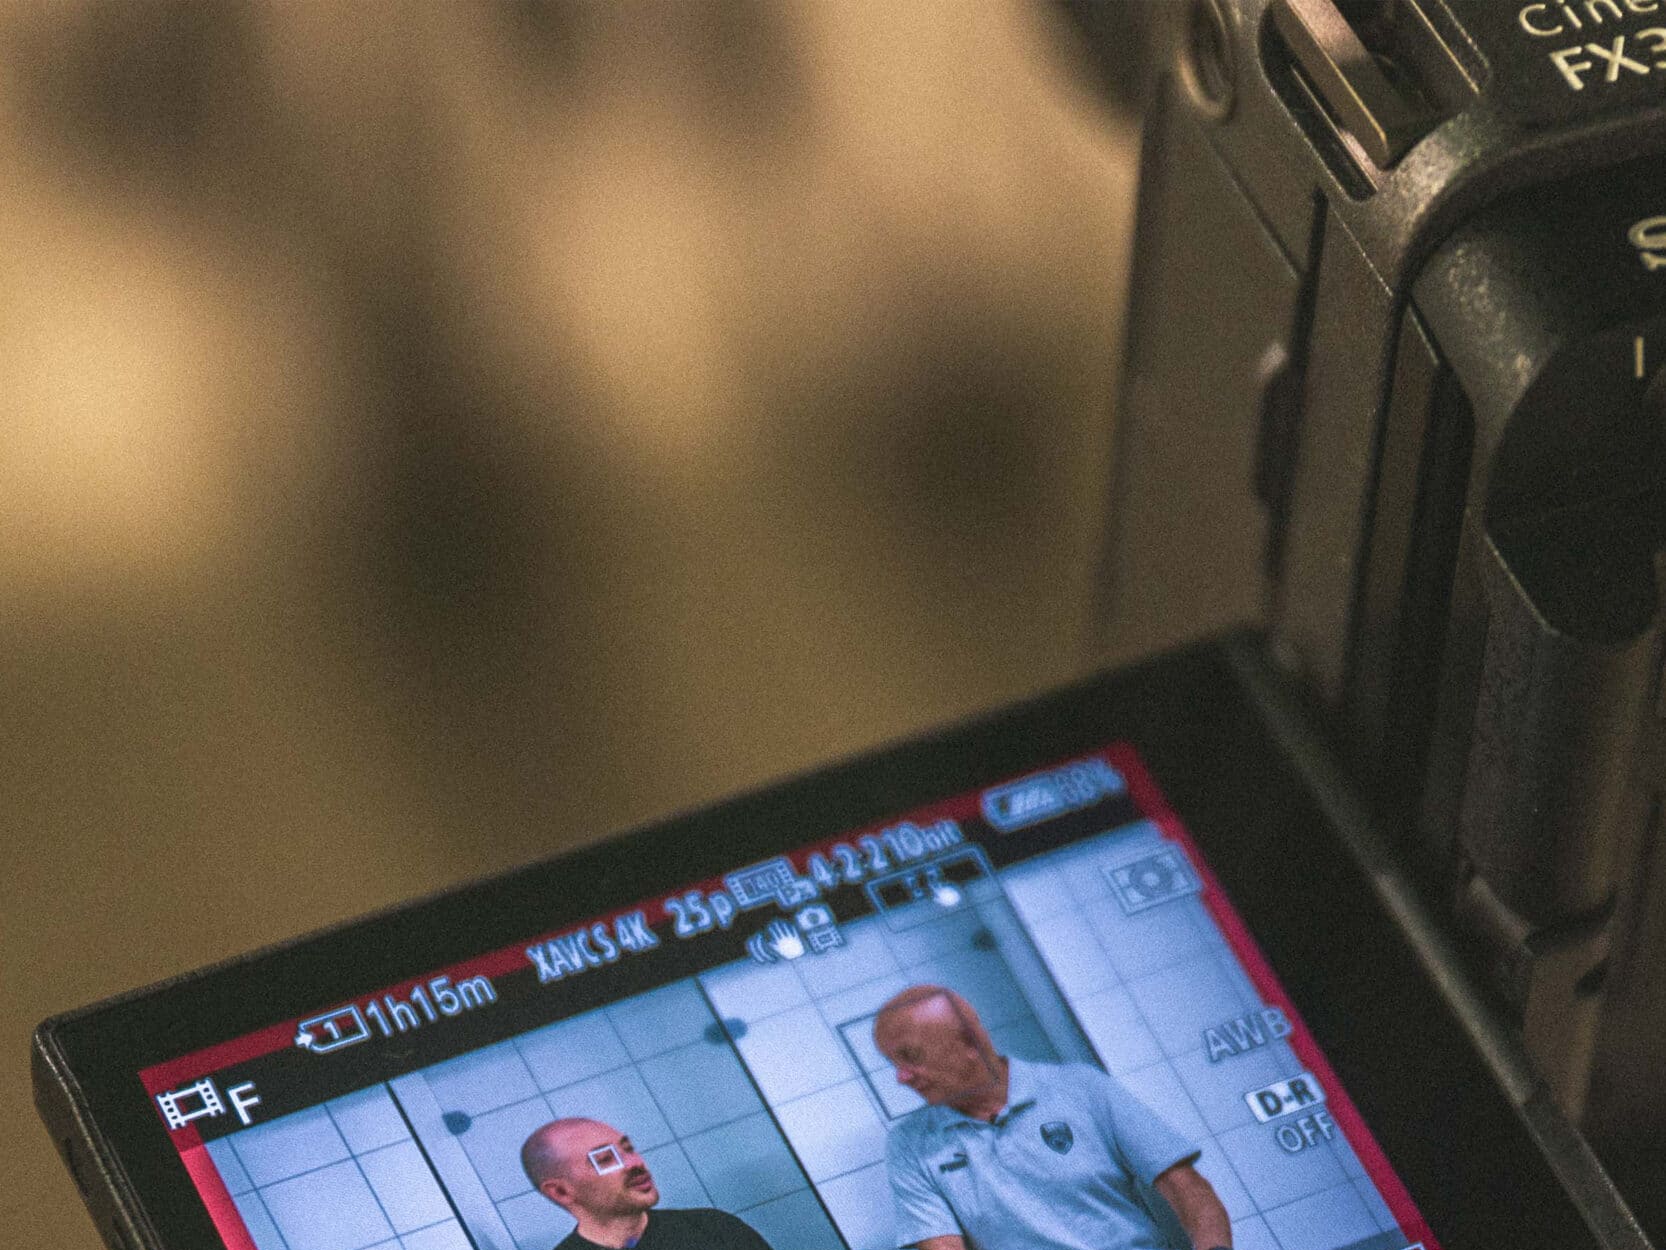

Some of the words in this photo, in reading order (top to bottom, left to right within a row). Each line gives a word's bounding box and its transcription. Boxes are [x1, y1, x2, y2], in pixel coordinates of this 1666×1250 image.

[664, 890, 736, 938] 25p
[367, 975, 496, 1037] 1h15m
[1203, 1006, 1292, 1065] AWB
[227, 1081, 262, 1125] F
[1275, 1112, 1336, 1154] OFF
